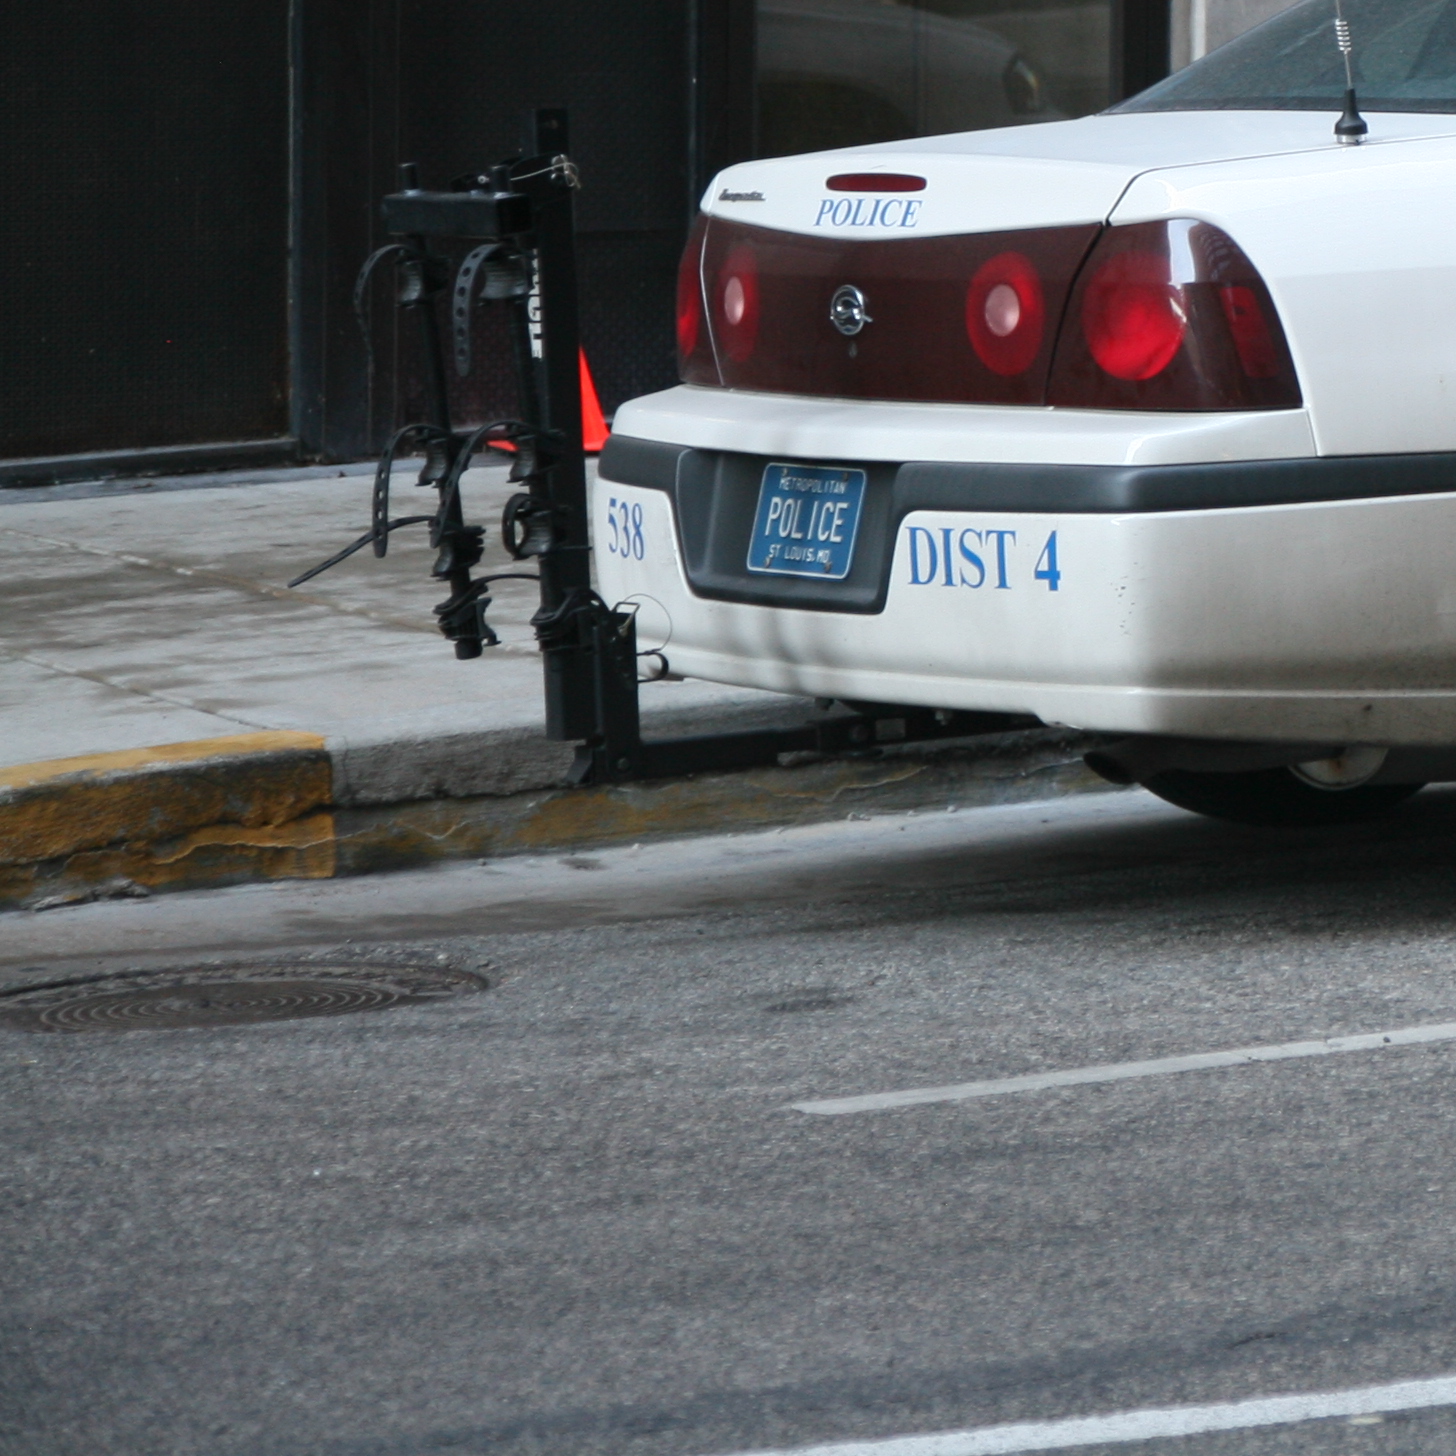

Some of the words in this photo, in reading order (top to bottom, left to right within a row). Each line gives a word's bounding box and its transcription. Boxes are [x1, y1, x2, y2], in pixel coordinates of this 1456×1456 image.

[813, 198, 923, 228] POLICE
[779, 476, 849, 495] METROPOLITAN
[607, 497, 645, 561] 538
[764, 496, 850, 543] POLICE
[905, 526, 1017, 589] DIST
[1034, 530, 1061, 591] 4
